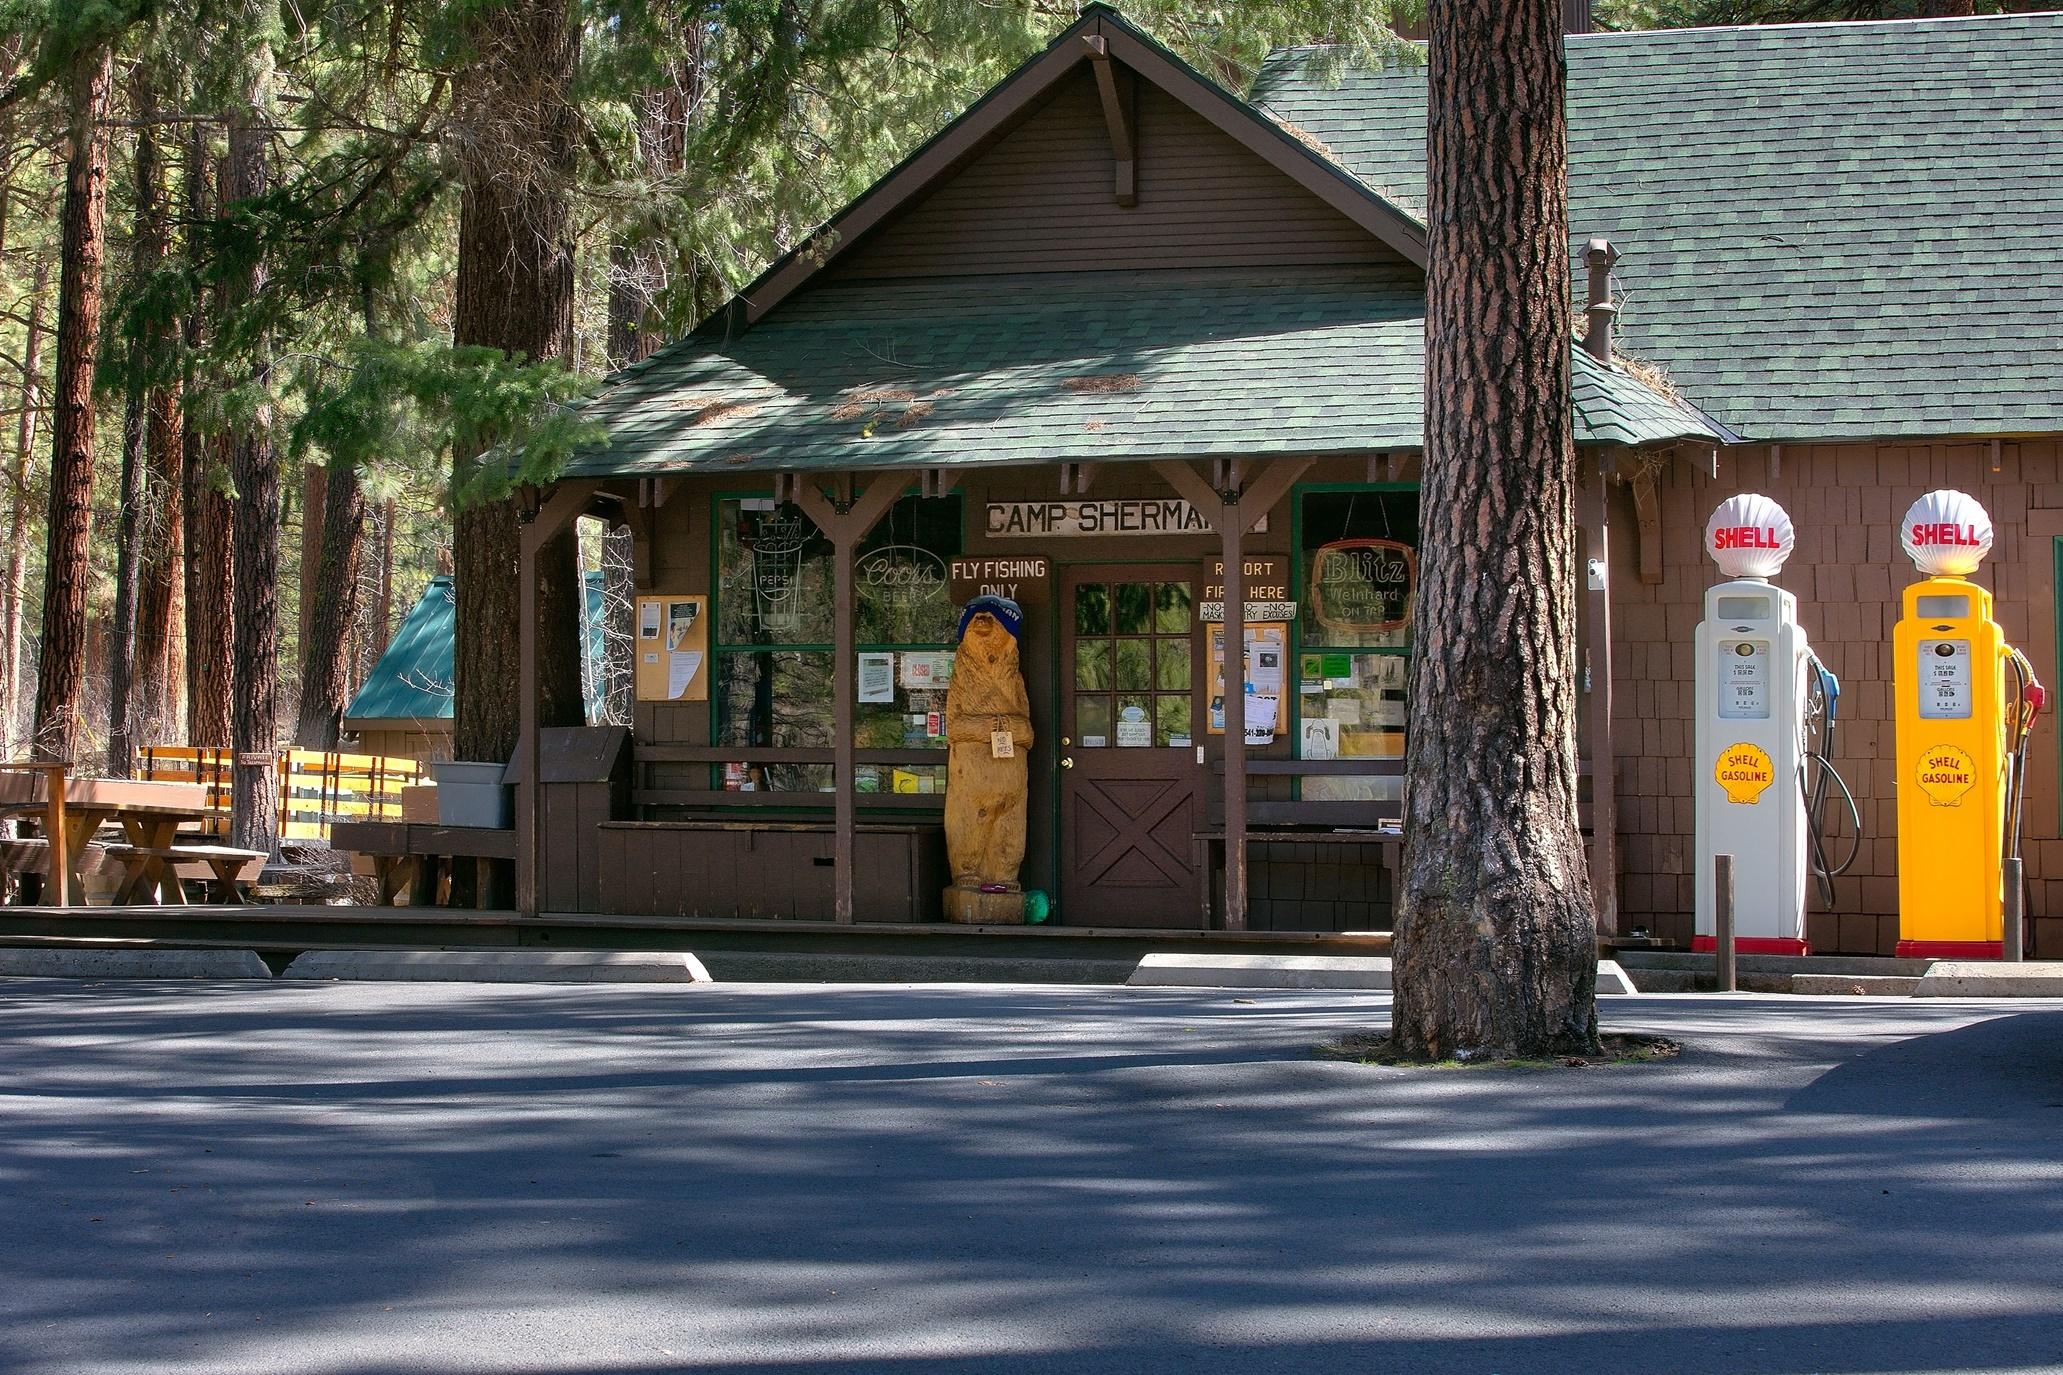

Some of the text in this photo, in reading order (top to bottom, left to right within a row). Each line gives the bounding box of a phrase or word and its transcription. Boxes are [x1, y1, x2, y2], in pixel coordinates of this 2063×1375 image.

[986, 500, 1210, 533] CAMP SHERMA
[1714, 526, 1780, 549] SHELL
[1912, 524, 1980, 546] SHELL
[863, 558, 940, 586] Coors
[952, 560, 1046, 580] FLY FISHING
[1215, 562, 1274, 576] RORT
[1322, 552, 1405, 583] Blitz
[759, 575, 793, 585] PEPSI
[980, 583, 1018, 600] ONLY
[1250, 586, 1285, 599] HERE
[1202, 609, 1224, 620] MASK
[1342, 606, 1359, 617] ON
[1728, 755, 1758, 768] SHELL
[1929, 757, 1960, 770] SHELL
[1721, 770, 1767, 782] GASOLINE
[1922, 773, 1969, 785] GASOLINE
